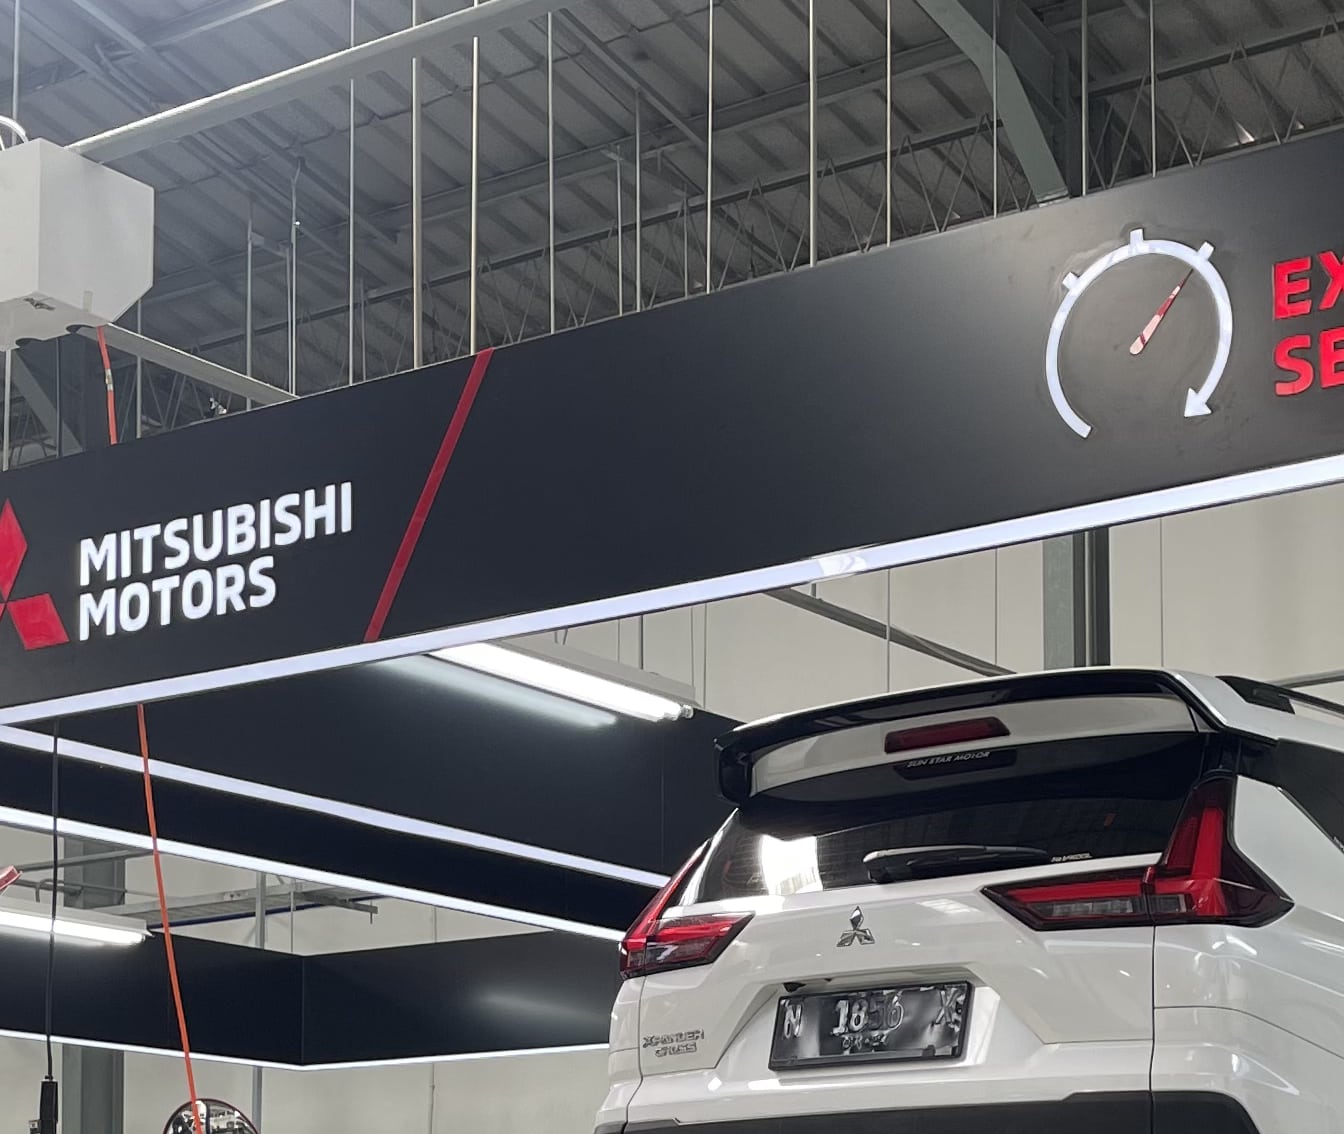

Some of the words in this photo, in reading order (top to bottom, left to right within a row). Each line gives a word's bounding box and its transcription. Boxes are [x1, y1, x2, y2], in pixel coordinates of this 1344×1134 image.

[78, 481, 353, 586] MITSUBISHI
[78, 555, 276, 641] MOTORS
[784, 1003, 802, 1039] N
